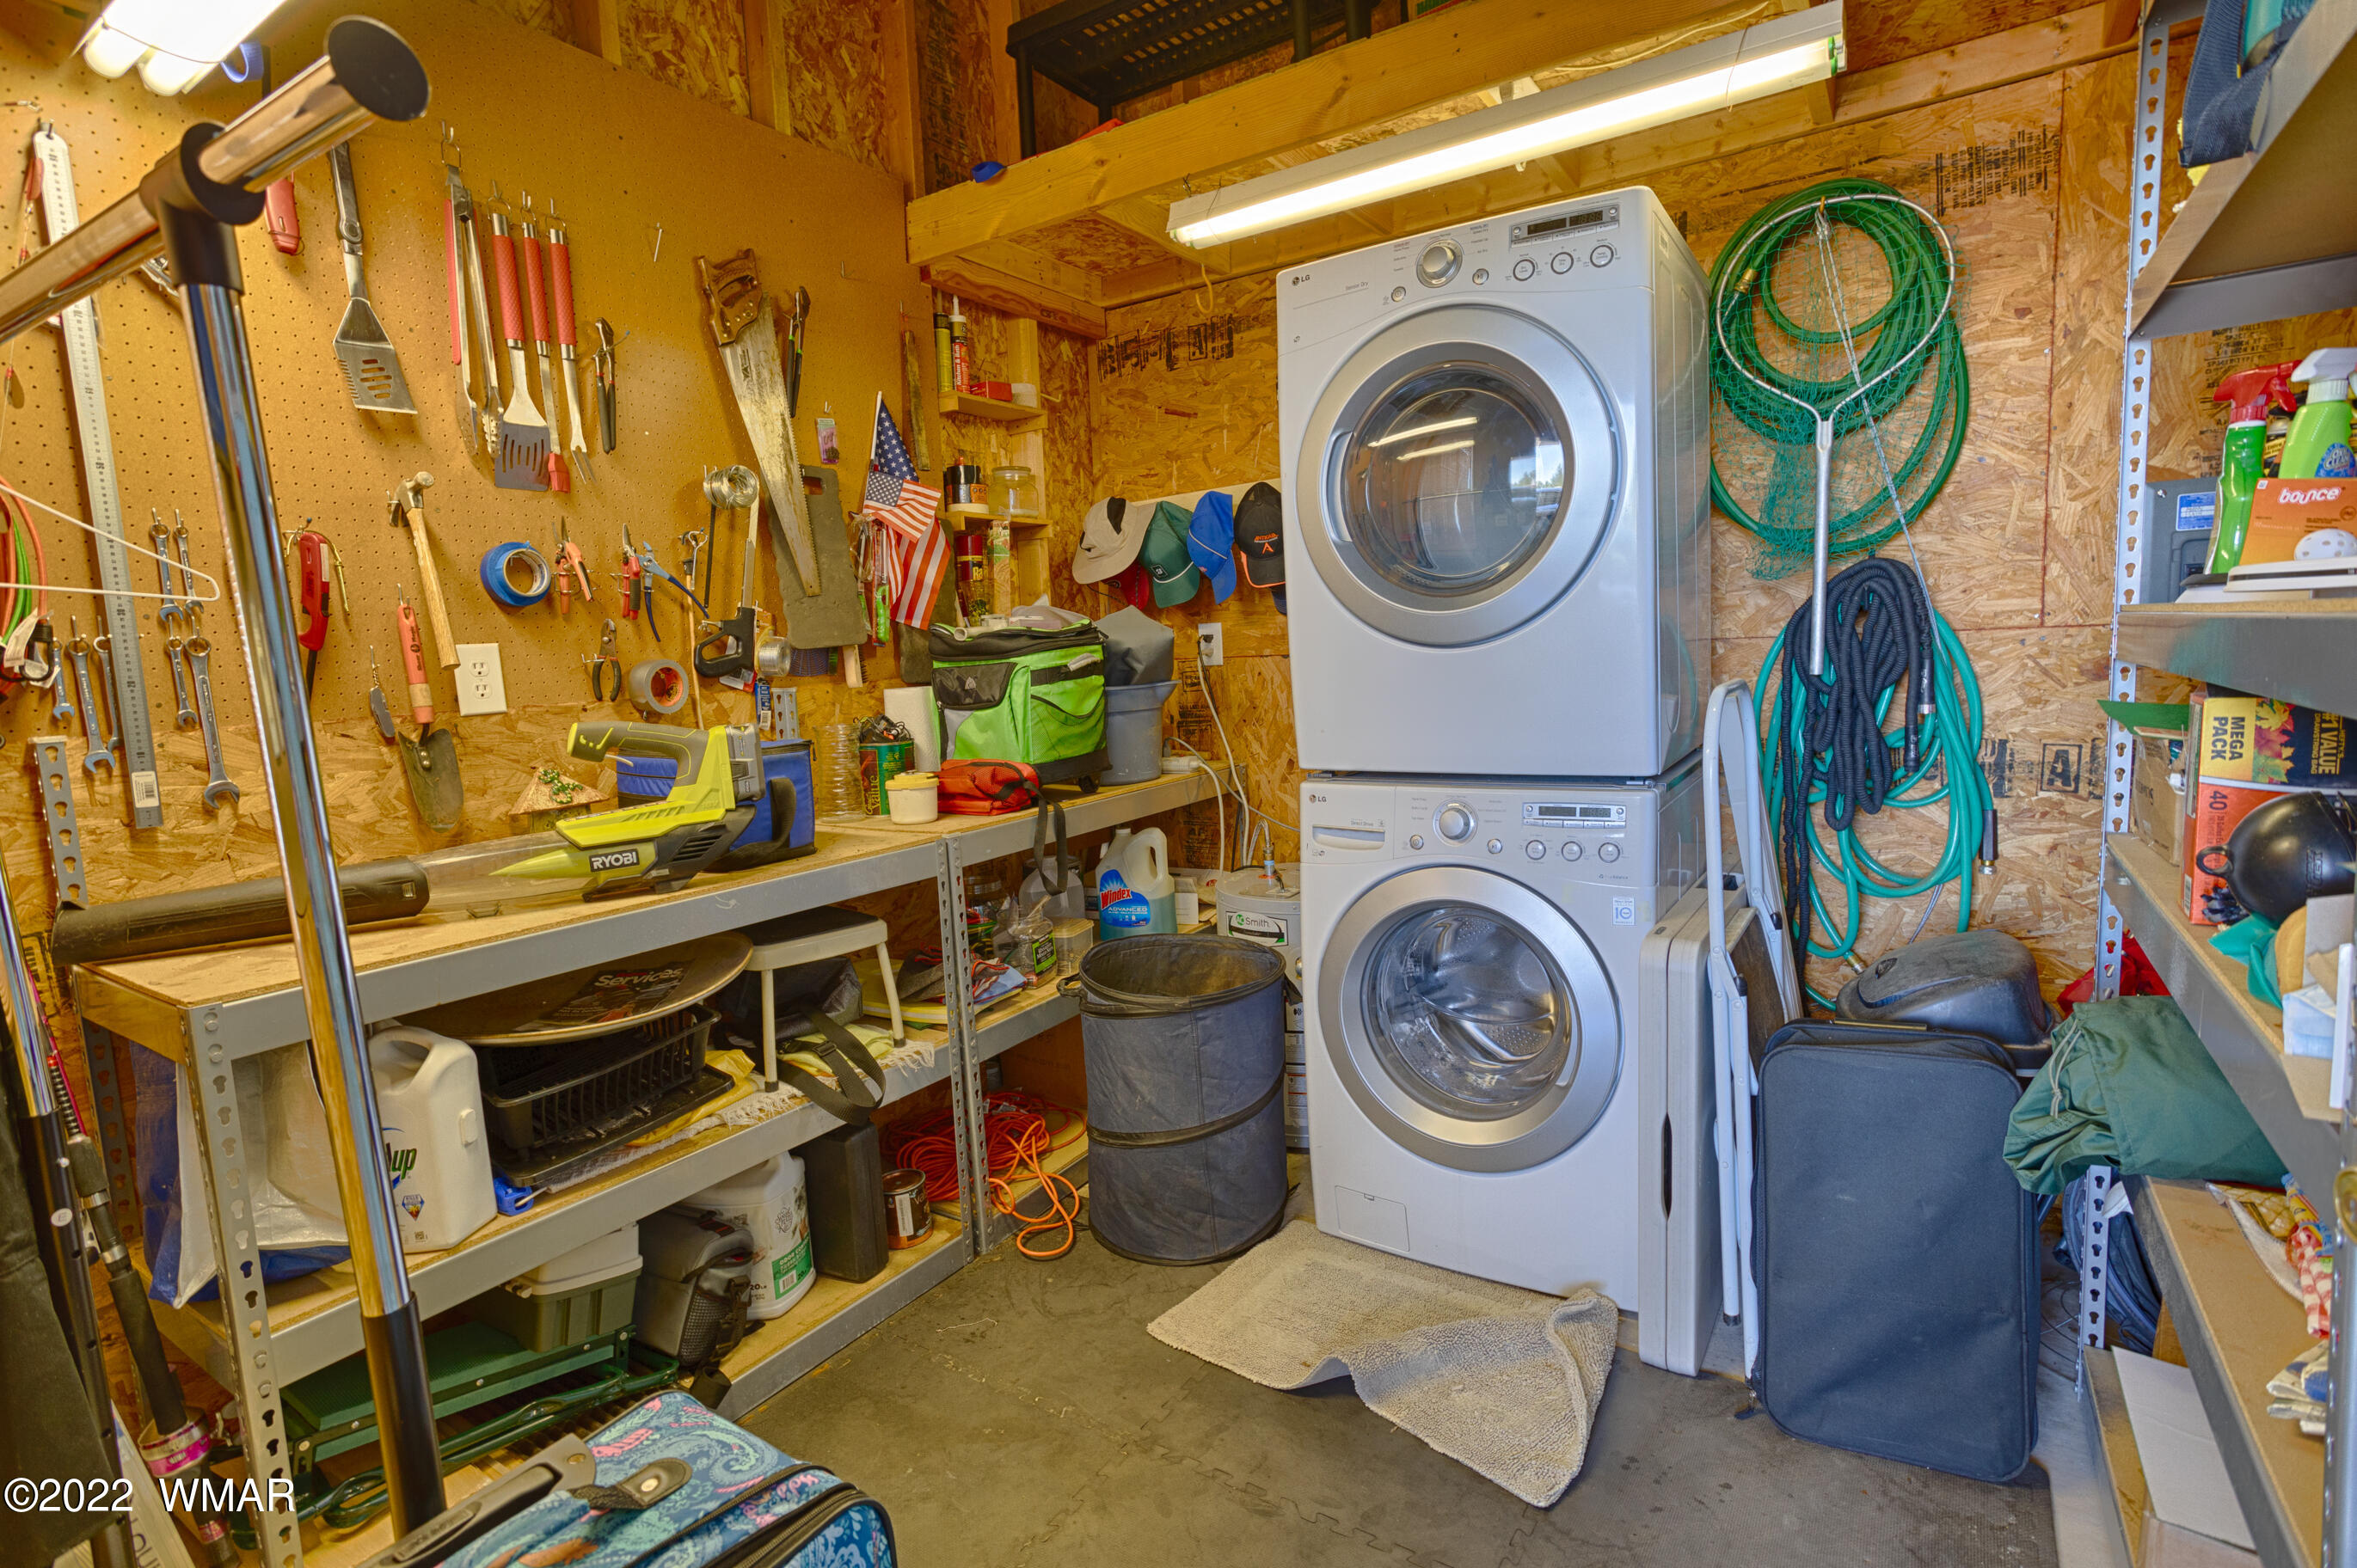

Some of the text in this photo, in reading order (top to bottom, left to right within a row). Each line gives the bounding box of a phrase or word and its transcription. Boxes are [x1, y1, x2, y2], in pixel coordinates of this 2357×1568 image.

[1300, 274, 1310, 283] LG
[2278, 487, 2342, 505] bounce
[972, 566, 984, 581] Ra
[2211, 716, 2229, 762] PACK
[2229, 716, 2246, 762] MEGA
[2319, 731, 2339, 775] VALUE
[2311, 759, 2320, 775] BAG
[869, 775, 881, 809] Value
[2209, 790, 2228, 811] 40
[591, 851, 638, 870] RYOBI
[1101, 887, 1132, 910] Windex
[1245, 916, 1269, 928] Smith
[593, 967, 684, 987] Services
